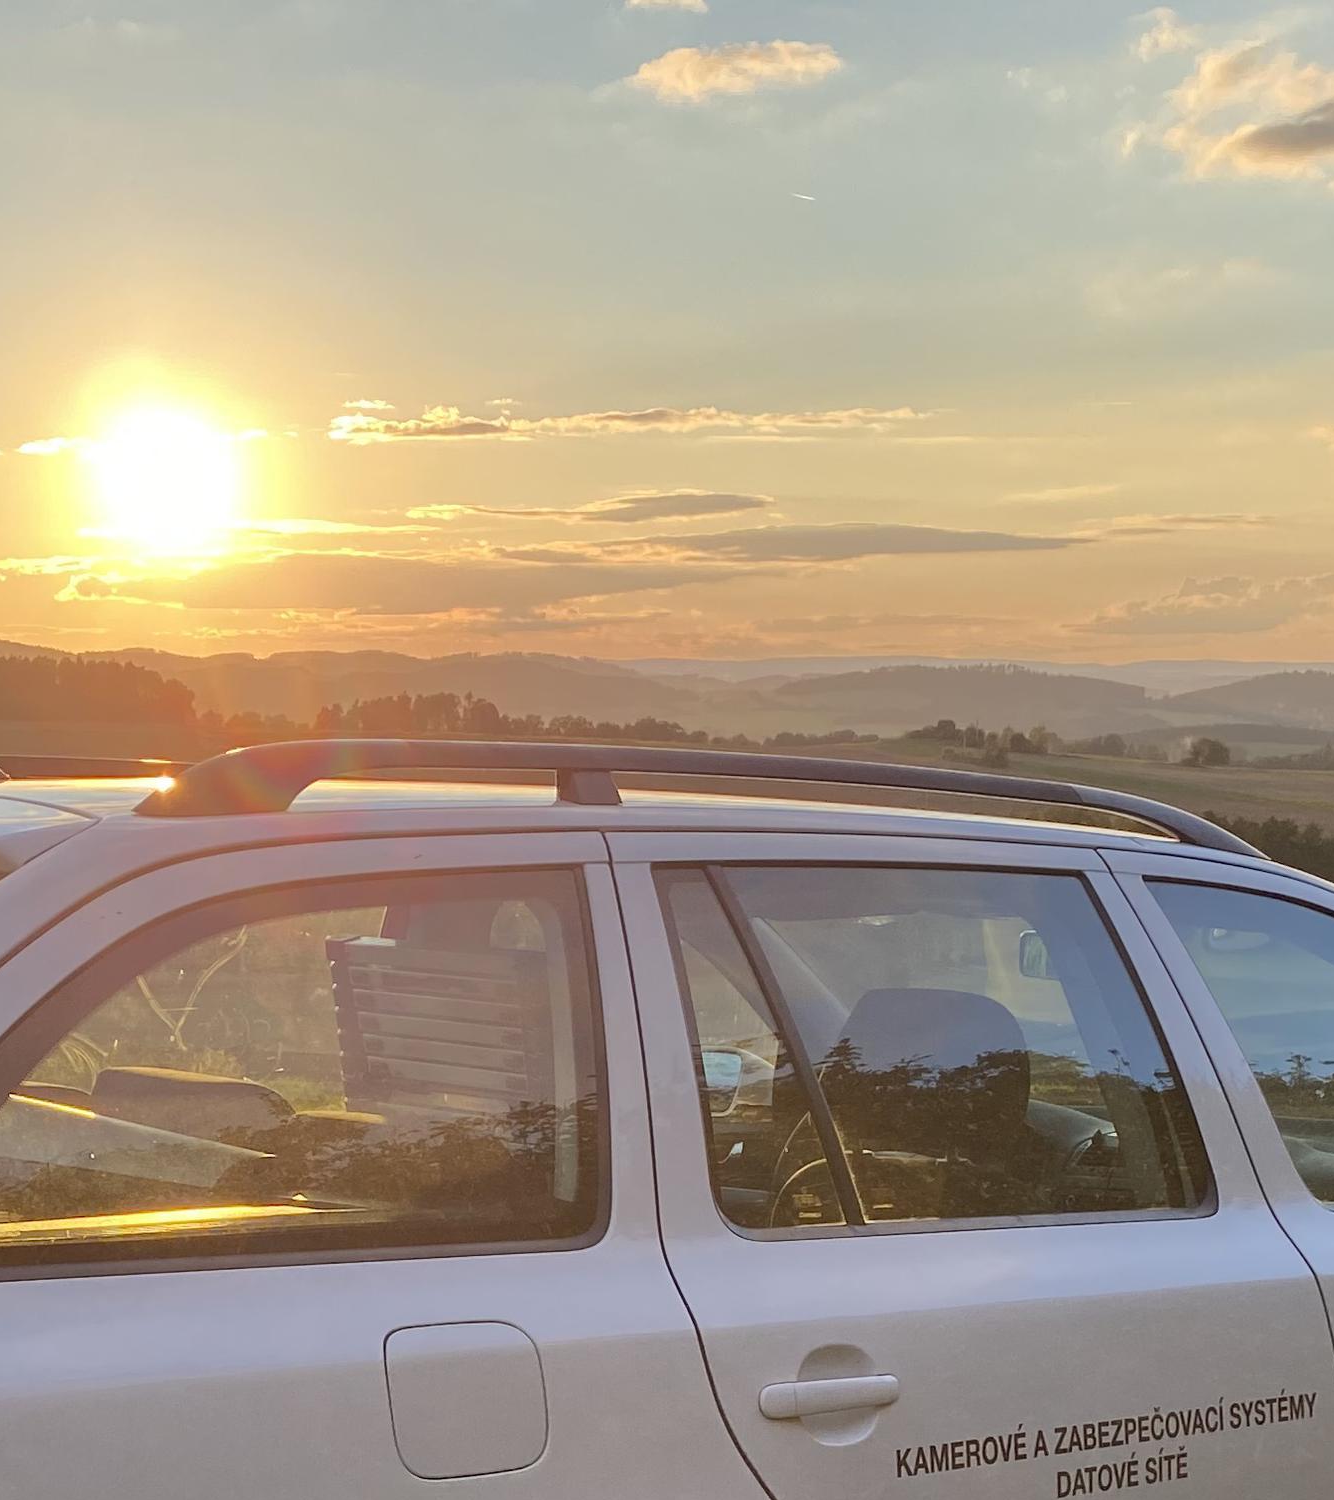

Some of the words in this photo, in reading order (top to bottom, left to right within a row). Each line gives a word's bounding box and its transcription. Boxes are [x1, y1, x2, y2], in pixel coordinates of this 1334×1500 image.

[896, 1423, 1028, 1478] KAMEROVÉ
[1033, 1429, 1050, 1459] A
[1053, 1397, 1226, 1455] ZABEZPEČOVACÍ
[1229, 1388, 1318, 1429] SYSTÉMY
[1056, 1452, 1139, 1498] DATOVÉ
[1145, 1446, 1189, 1483] SÍTĚ
